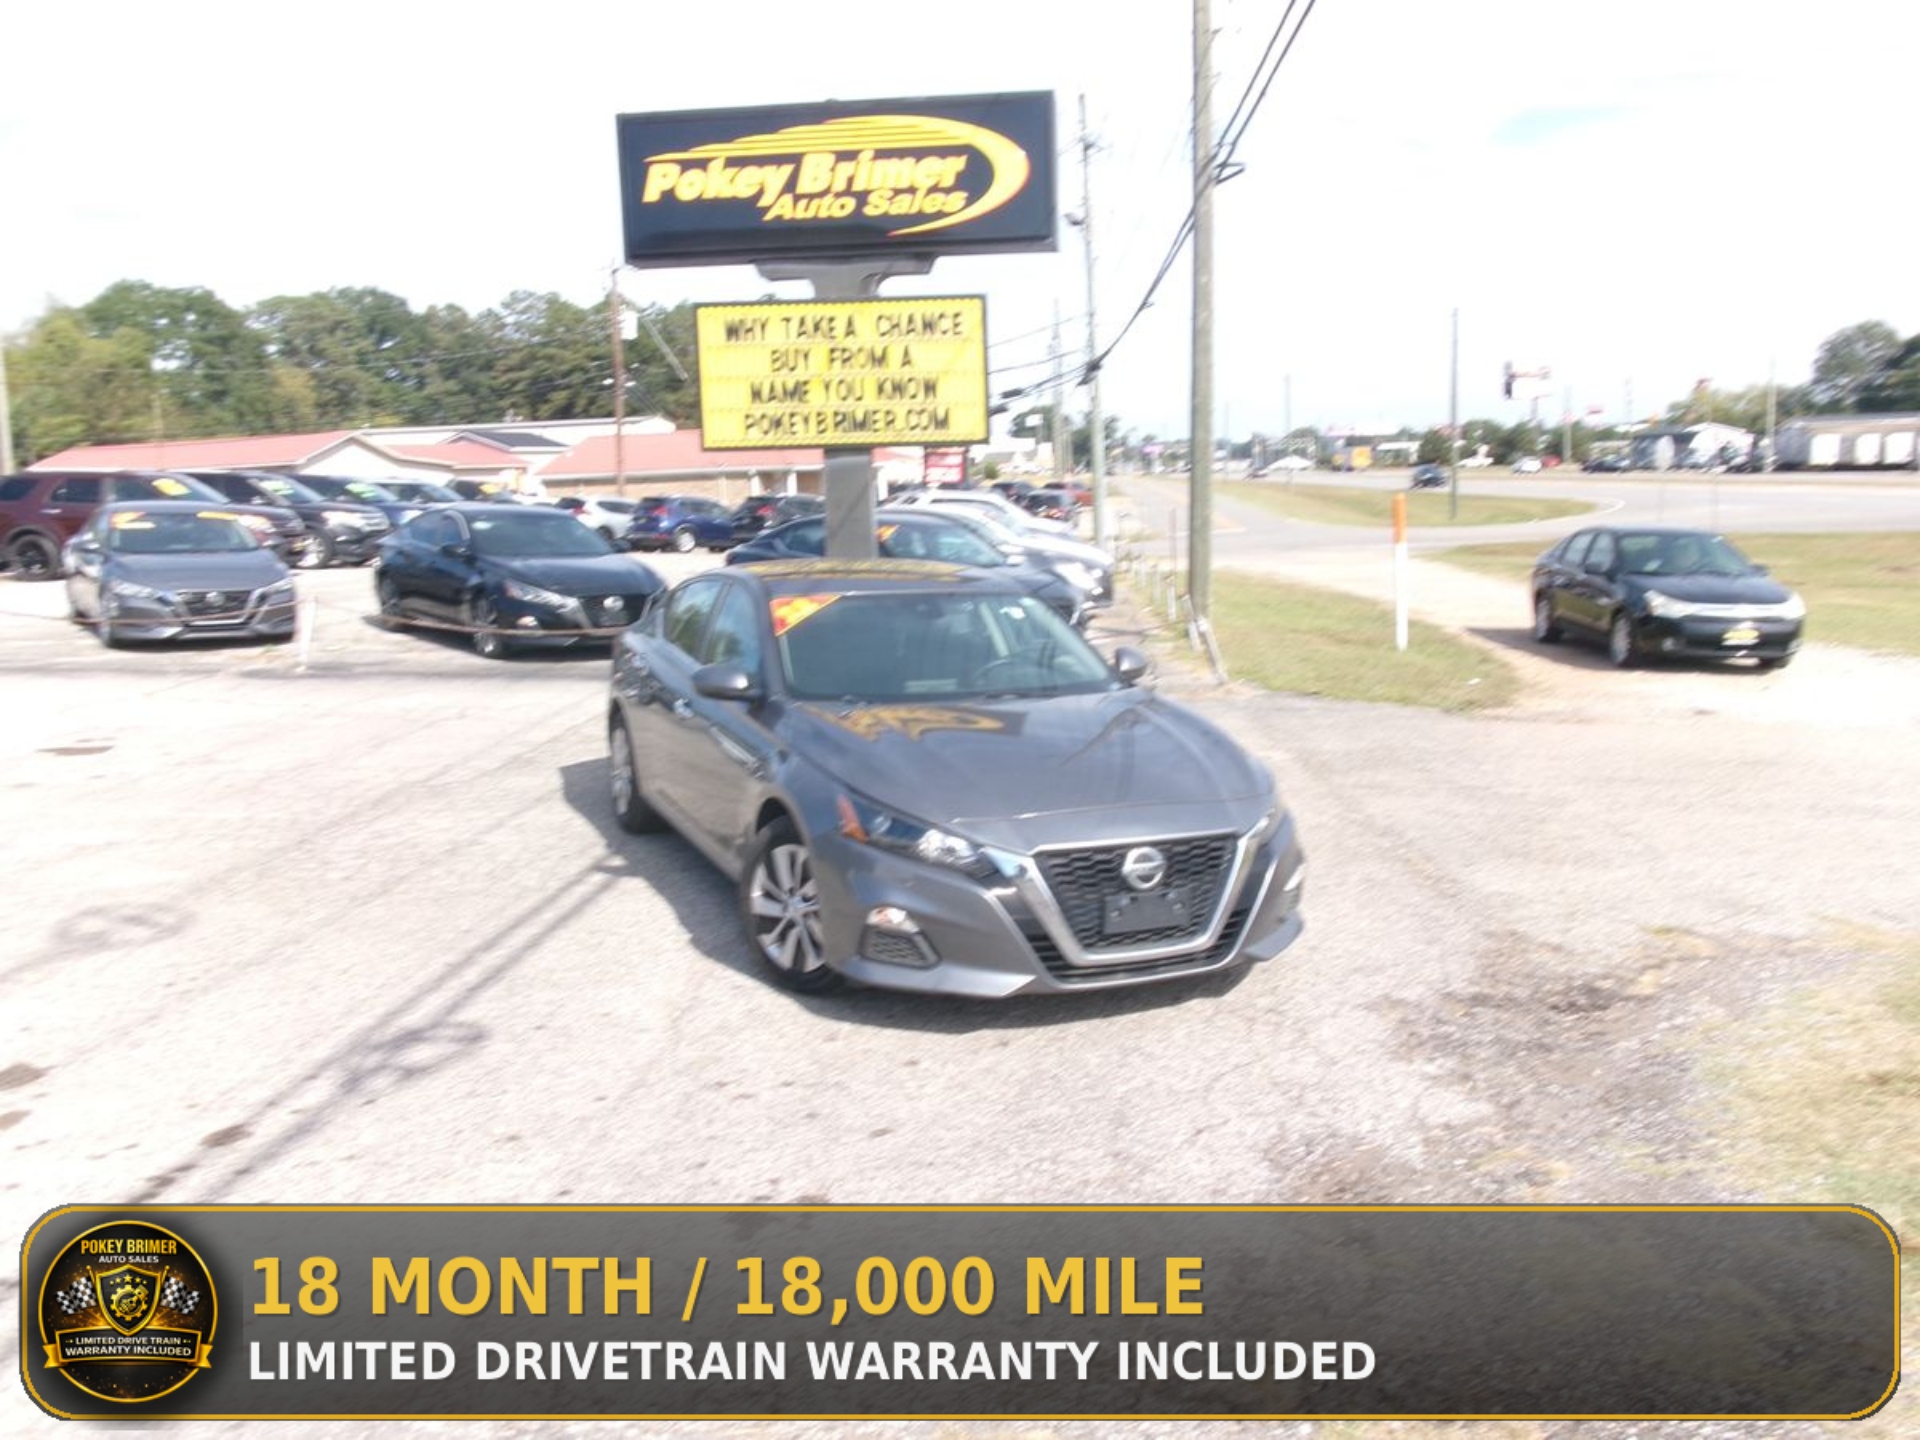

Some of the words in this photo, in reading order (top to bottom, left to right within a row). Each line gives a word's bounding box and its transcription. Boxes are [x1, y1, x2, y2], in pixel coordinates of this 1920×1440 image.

[642, 157, 797, 208] Pokey
[795, 149, 968, 196] Brimer
[762, 192, 857, 222] Auto
[861, 188, 969, 217] Sales
[724, 319, 768, 342] WHY
[781, 317, 838, 340] TAKE
[875, 313, 963, 338] CHANCE
[770, 350, 810, 373] BUY
[828, 346, 890, 372] FROM
[900, 345, 914, 366] A
[750, 379, 811, 404] NAME
[820, 378, 864, 402] YOU
[876, 376, 938, 402] KNOW
